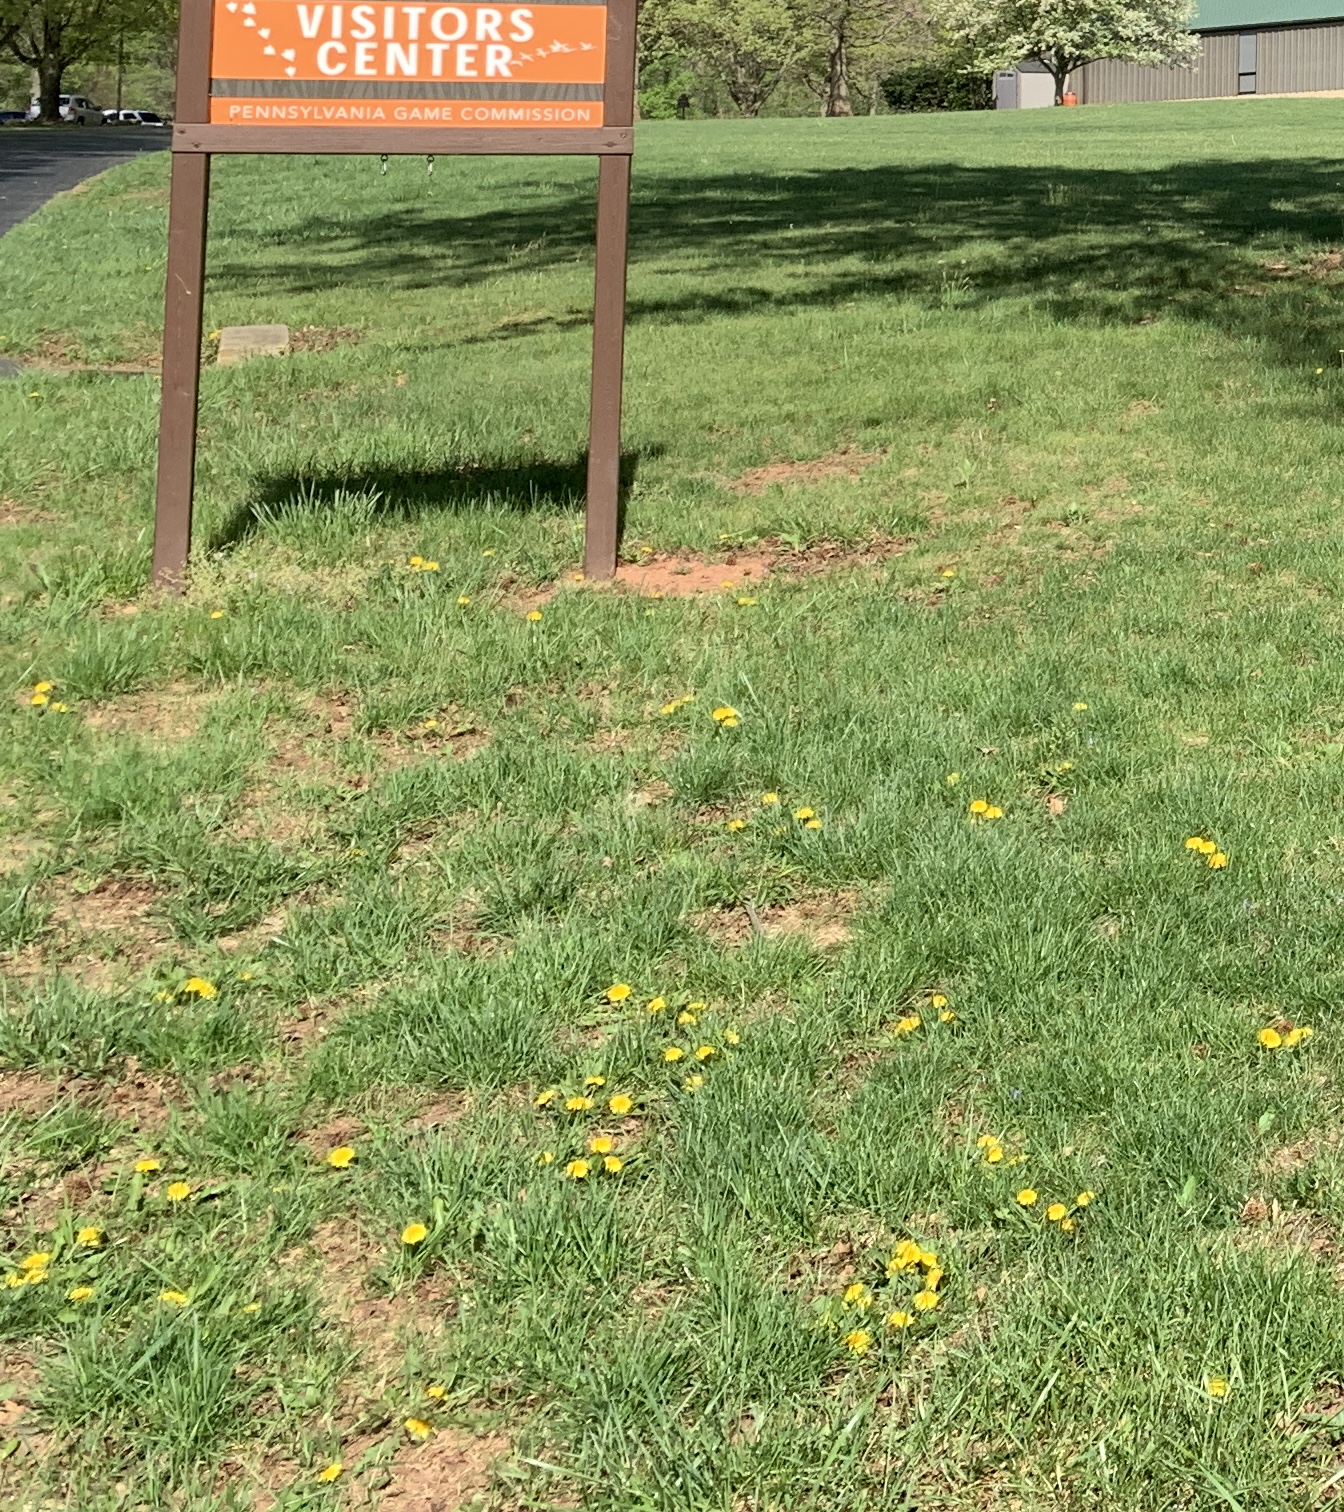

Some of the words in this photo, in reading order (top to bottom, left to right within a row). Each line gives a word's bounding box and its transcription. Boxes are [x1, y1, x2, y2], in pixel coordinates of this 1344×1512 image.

[296, 4, 535, 43] VISITORS
[316, 41, 513, 78] CENTER
[228, 104, 386, 122] PENNSYLVANIA
[393, 105, 453, 122] GAME
[460, 106, 591, 123] COMMISSION
